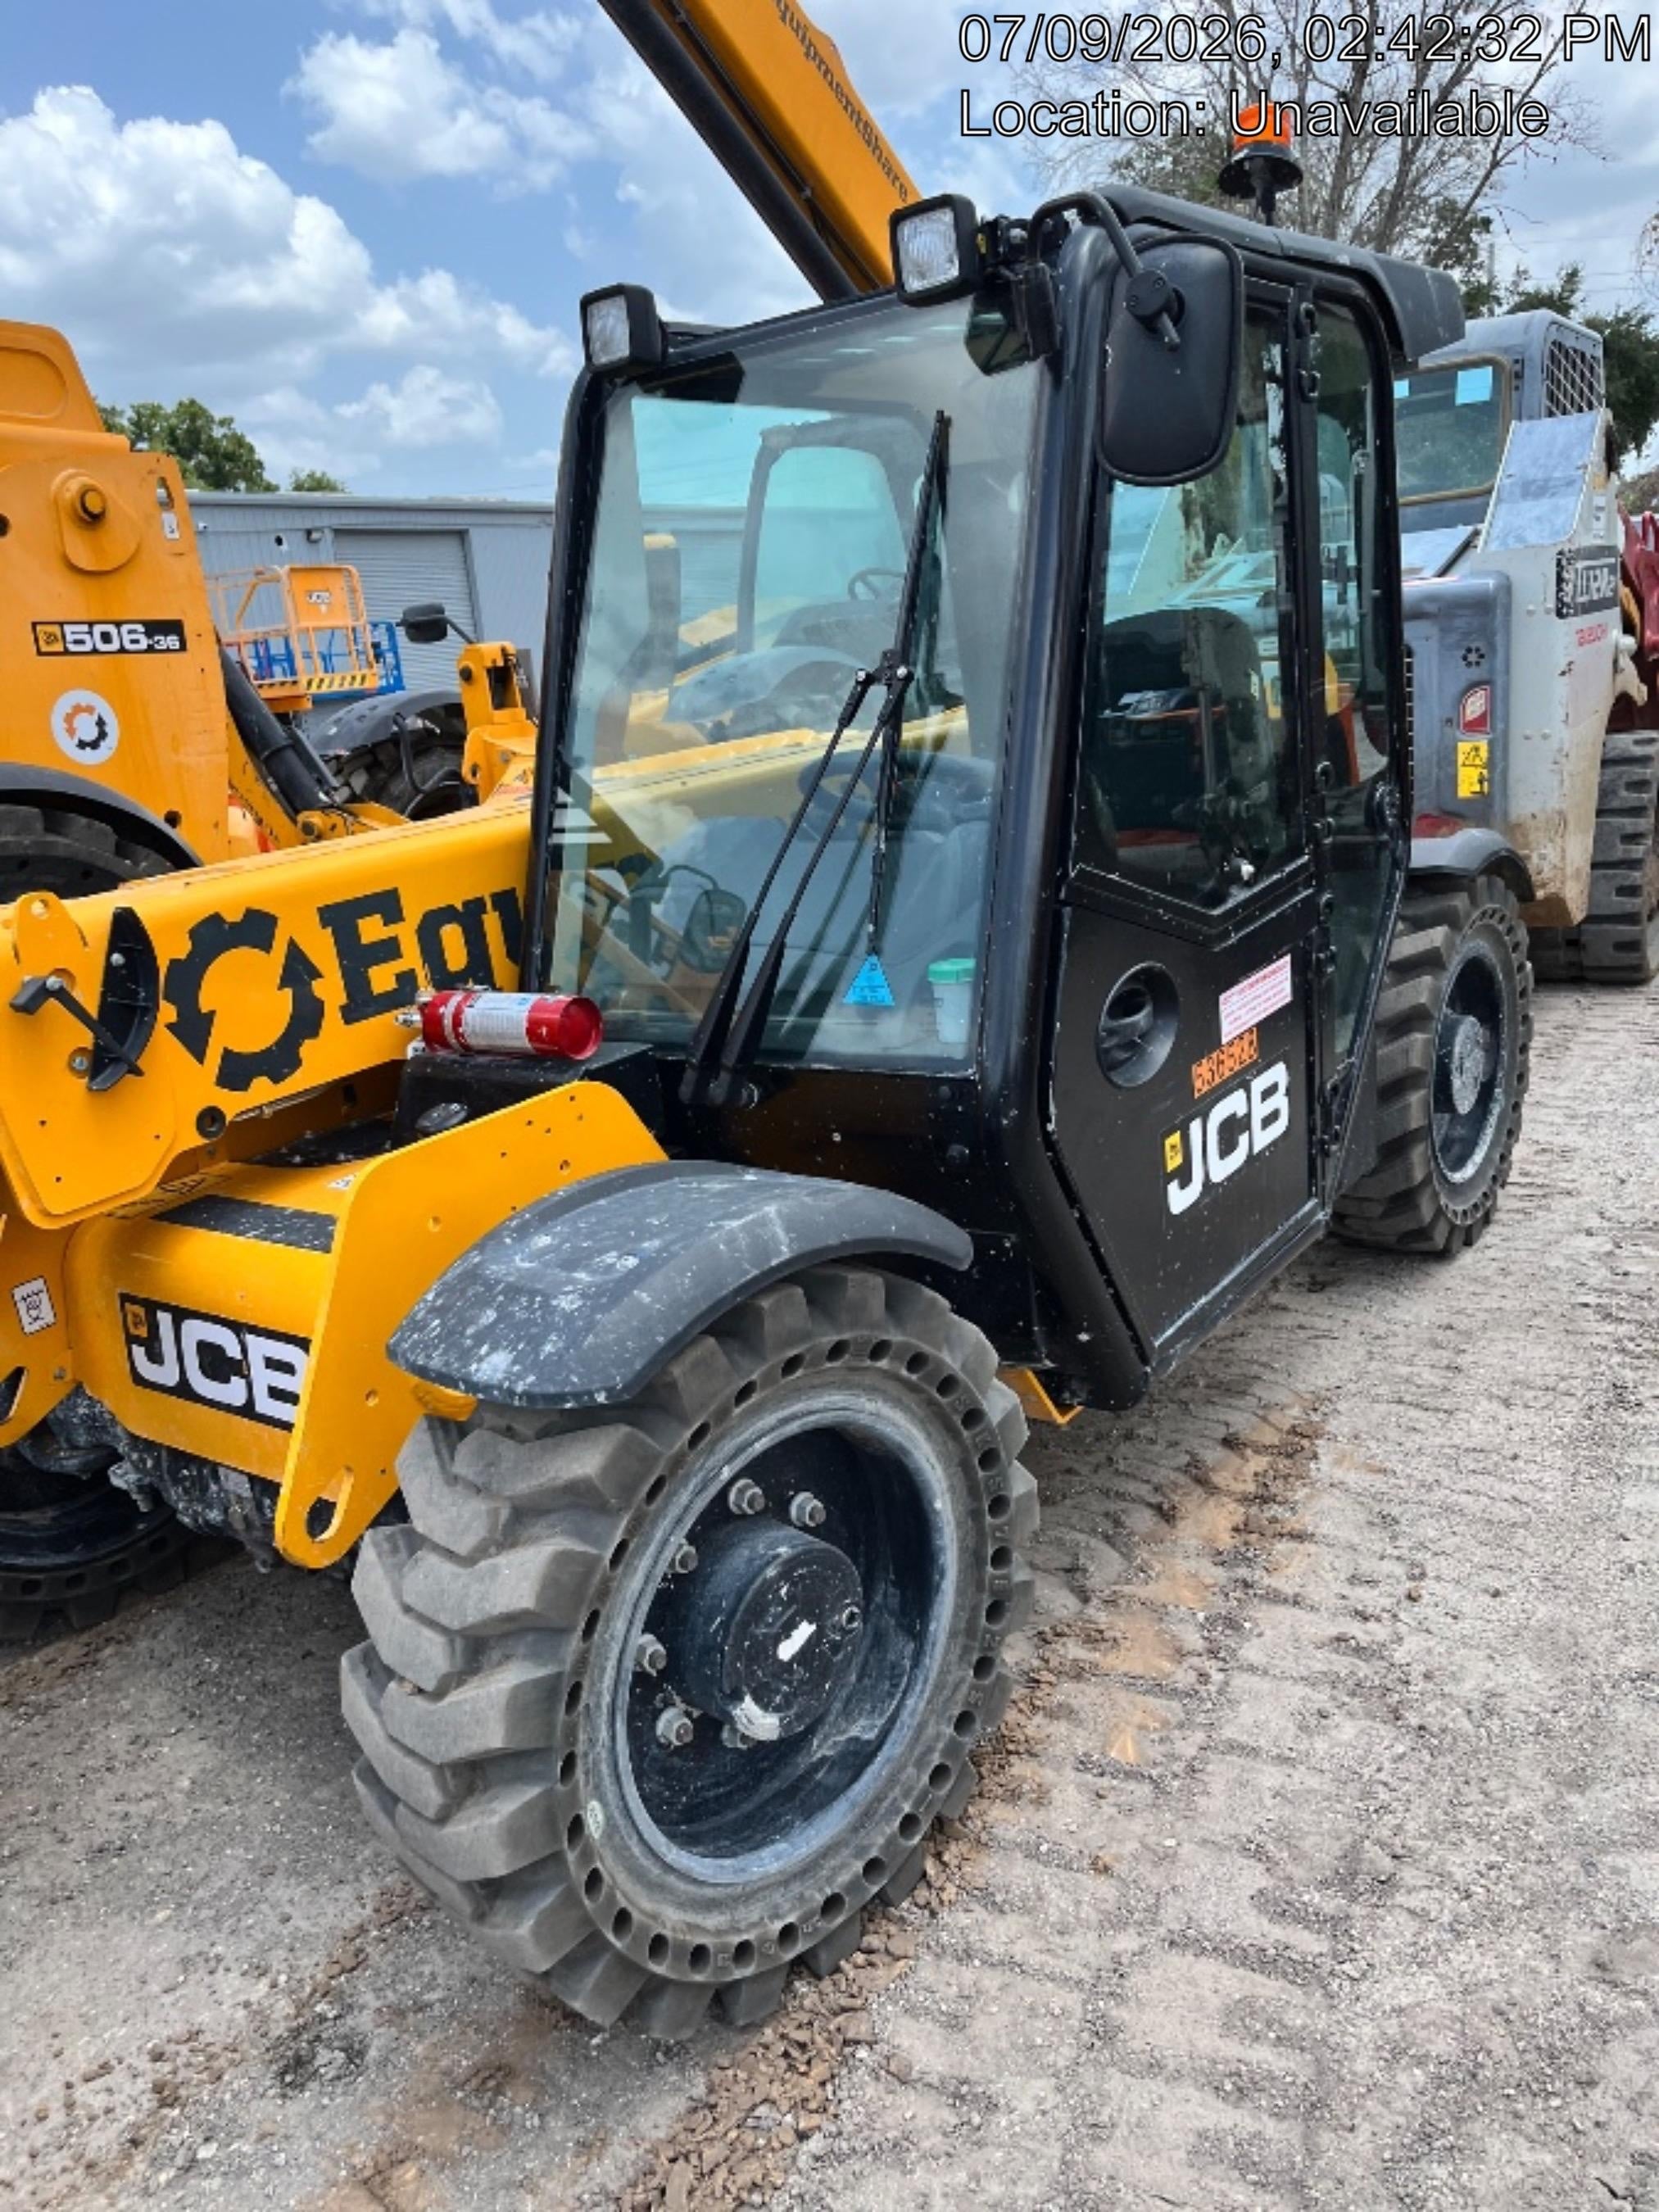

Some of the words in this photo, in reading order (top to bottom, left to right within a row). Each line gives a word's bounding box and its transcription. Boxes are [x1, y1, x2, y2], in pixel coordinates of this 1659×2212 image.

[63, 623, 179, 652] 506-36
[1167, 1061, 1290, 1215] JCB
[129, 1308, 310, 1423] JCB
